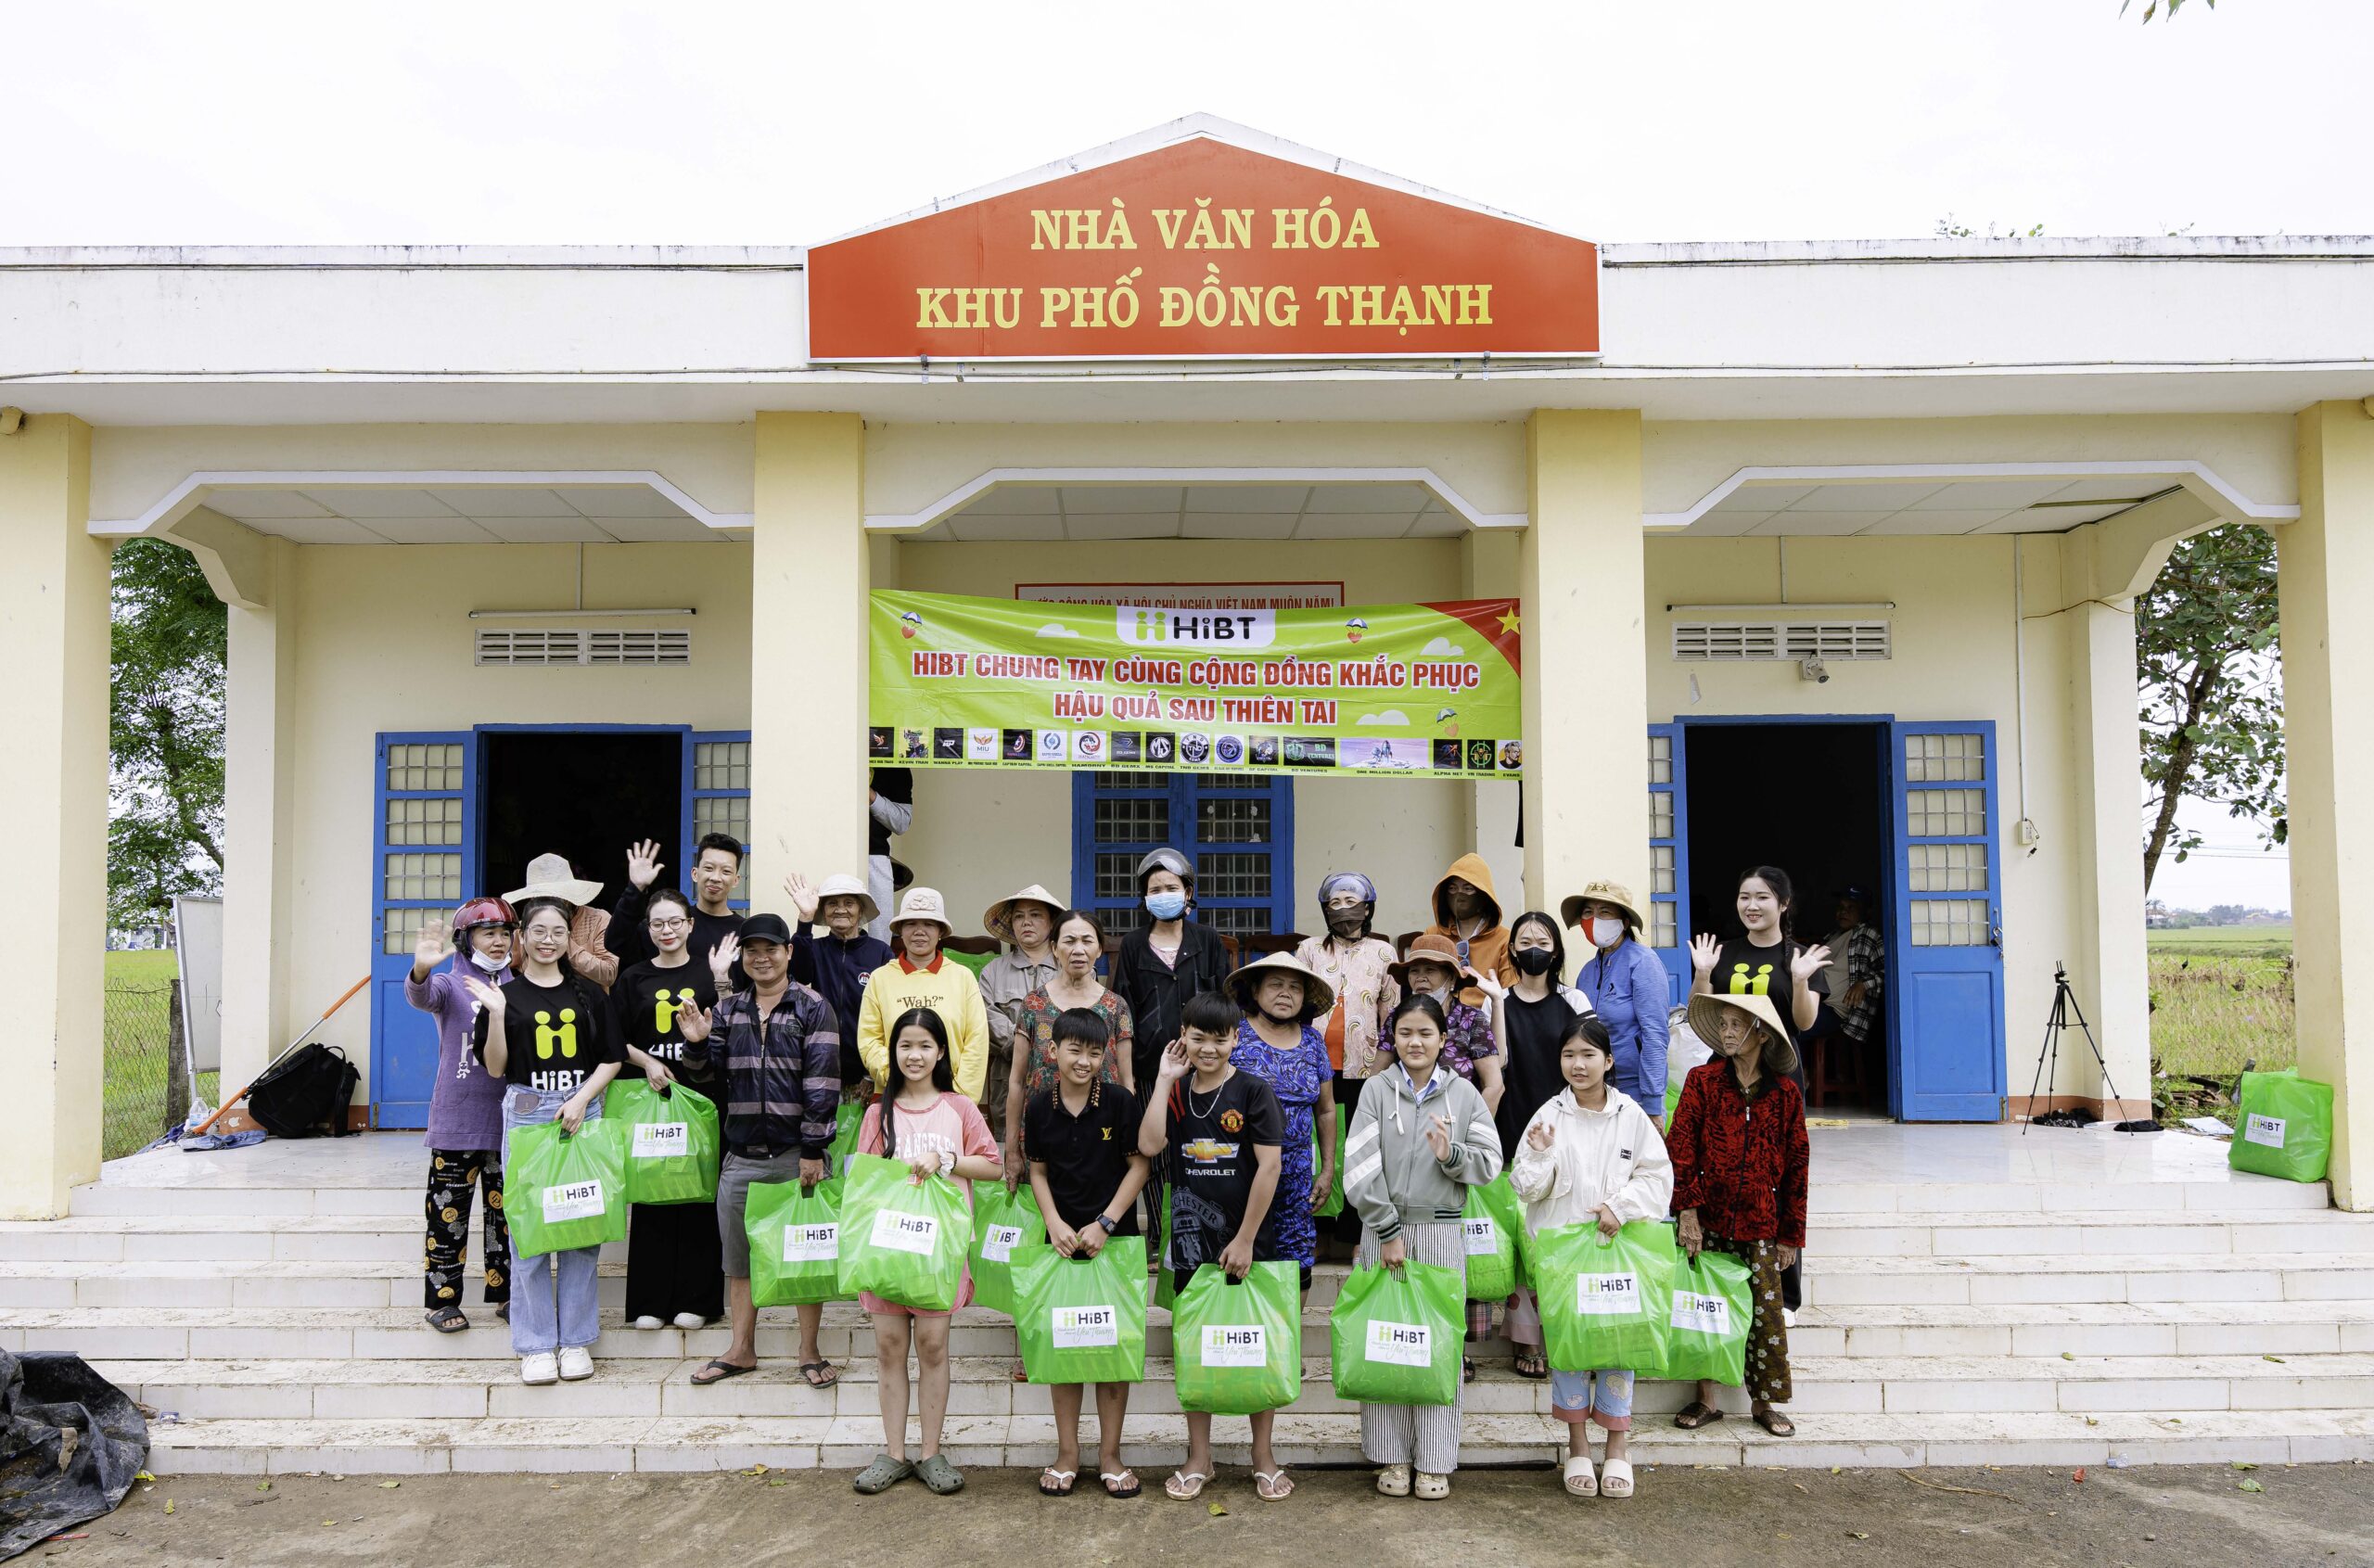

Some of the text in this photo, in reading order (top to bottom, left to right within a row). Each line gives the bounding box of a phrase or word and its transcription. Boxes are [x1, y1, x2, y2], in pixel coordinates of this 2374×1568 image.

[1030, 196, 1379, 250] NHÀ VĂN HÓA
[916, 262, 1492, 336] KHU PHỐ ĐỒNG THẠNH
[1241, 598, 1266, 609] NAM
[1173, 617, 1256, 640] HiBT
[913, 652, 1480, 693] HIBT CHUNG TAY CÙNG CỘNG ĐỒNG KHẮC PHỤC
[1054, 691, 1337, 724] HẬU QUẢ SAU THIÊN TAI
